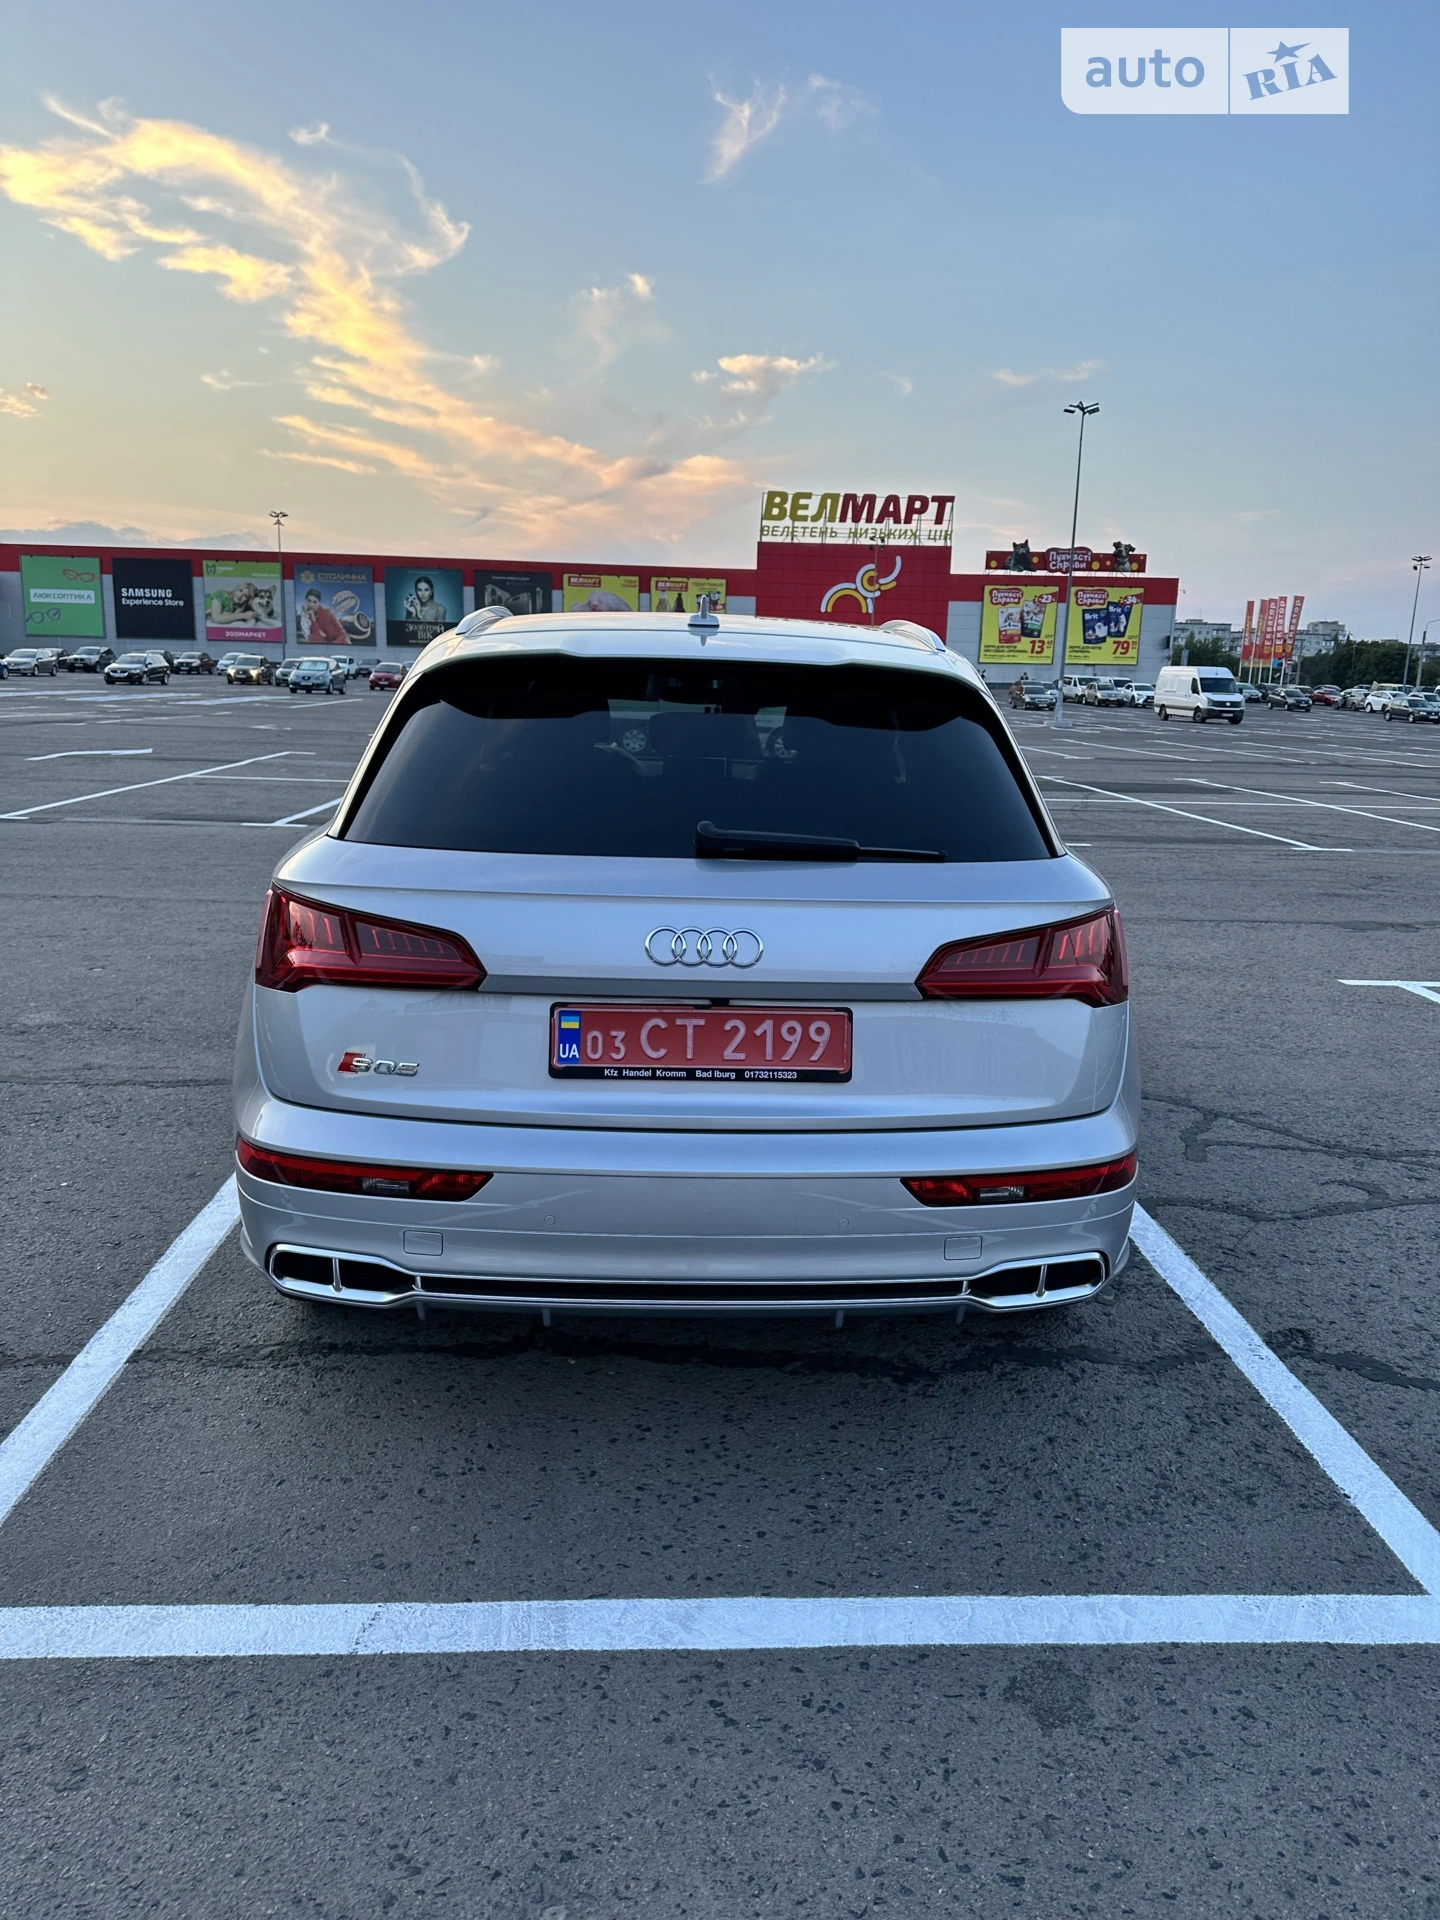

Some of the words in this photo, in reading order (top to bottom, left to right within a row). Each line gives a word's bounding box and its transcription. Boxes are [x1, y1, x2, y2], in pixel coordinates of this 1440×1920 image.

[762, 490, 955, 525] ВЕЛМАРТ
[760, 525, 838, 538] ВЕЛЕТЕНЬ
[848, 527, 919, 541] НИЗЬКИХ
[928, 529, 953, 543] ЦІН
[1049, 560, 1087, 572] Спрви
[32, 592, 92, 600] ЛЮКСОПТИКА
[121, 588, 172, 598] SAMSUNG
[121, 598, 163, 607] Experience
[164, 599, 184, 607] Store
[1029, 639, 1046, 655] 13
[1112, 640, 1130, 655] 79
[586, 1030, 626, 1060] 03
[722, 1018, 832, 1062] 2199
[559, 1043, 579, 1059] UA
[350, 1057, 420, 1077] SQ5
[604, 1068, 618, 1077] Kfz
[622, 1069, 652, 1077] Handel
[655, 1070, 686, 1078] Kromm
[695, 1070, 712, 1078] Bad
[713, 1070, 736, 1080] Iburg
[744, 1071, 797, 1079] 01732115323
